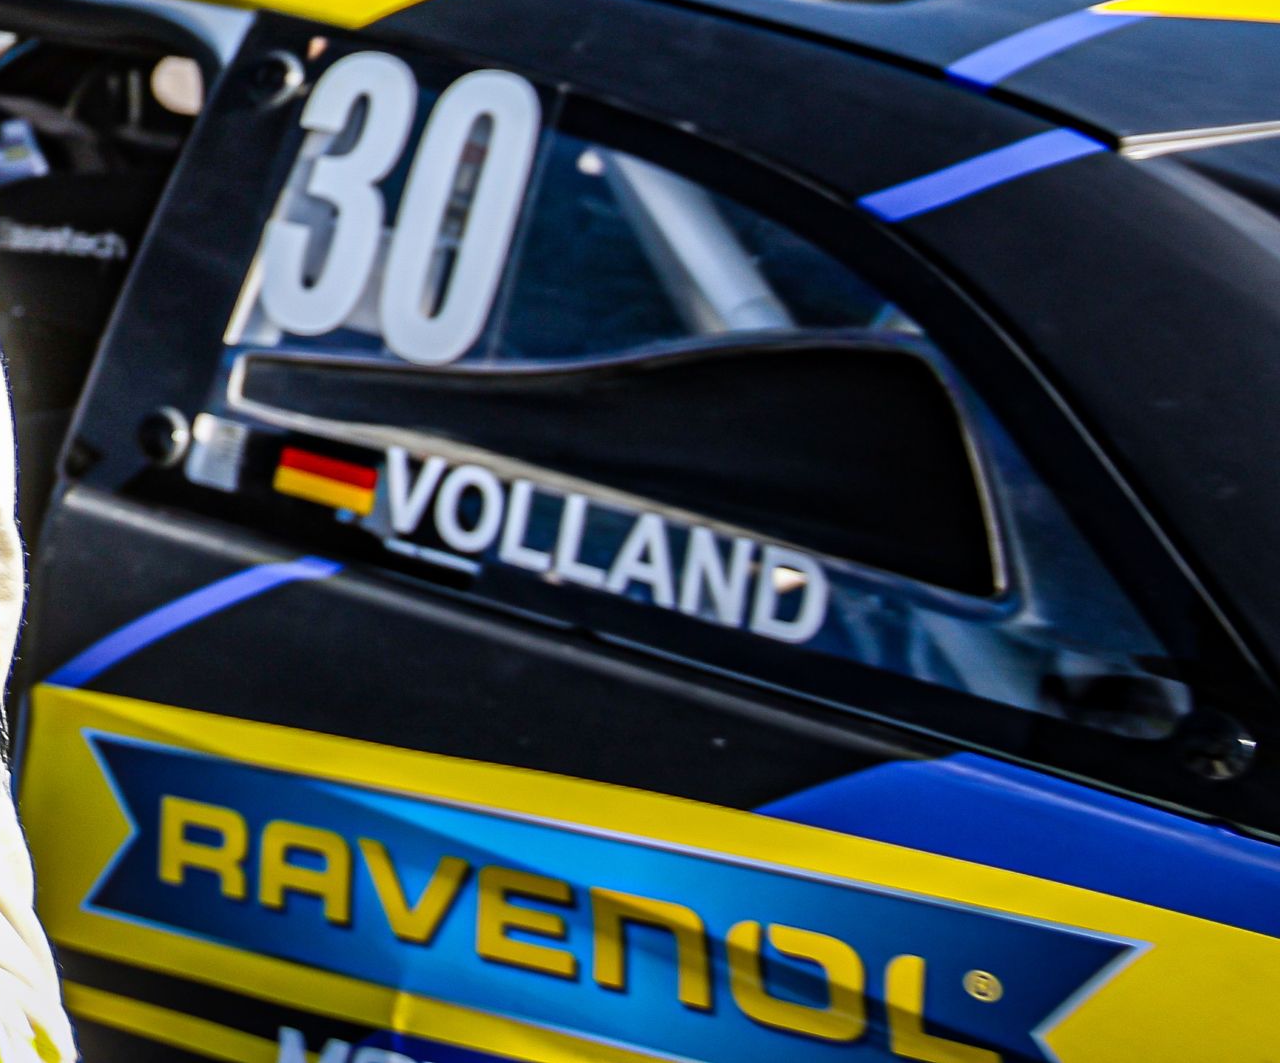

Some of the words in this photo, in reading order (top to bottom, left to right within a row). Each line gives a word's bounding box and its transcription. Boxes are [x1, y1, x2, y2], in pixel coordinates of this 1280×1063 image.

[258, 50, 542, 366] 30
[385, 446, 828, 645] VOLLAND
[156, 794, 1000, 1063] RAVENOL
